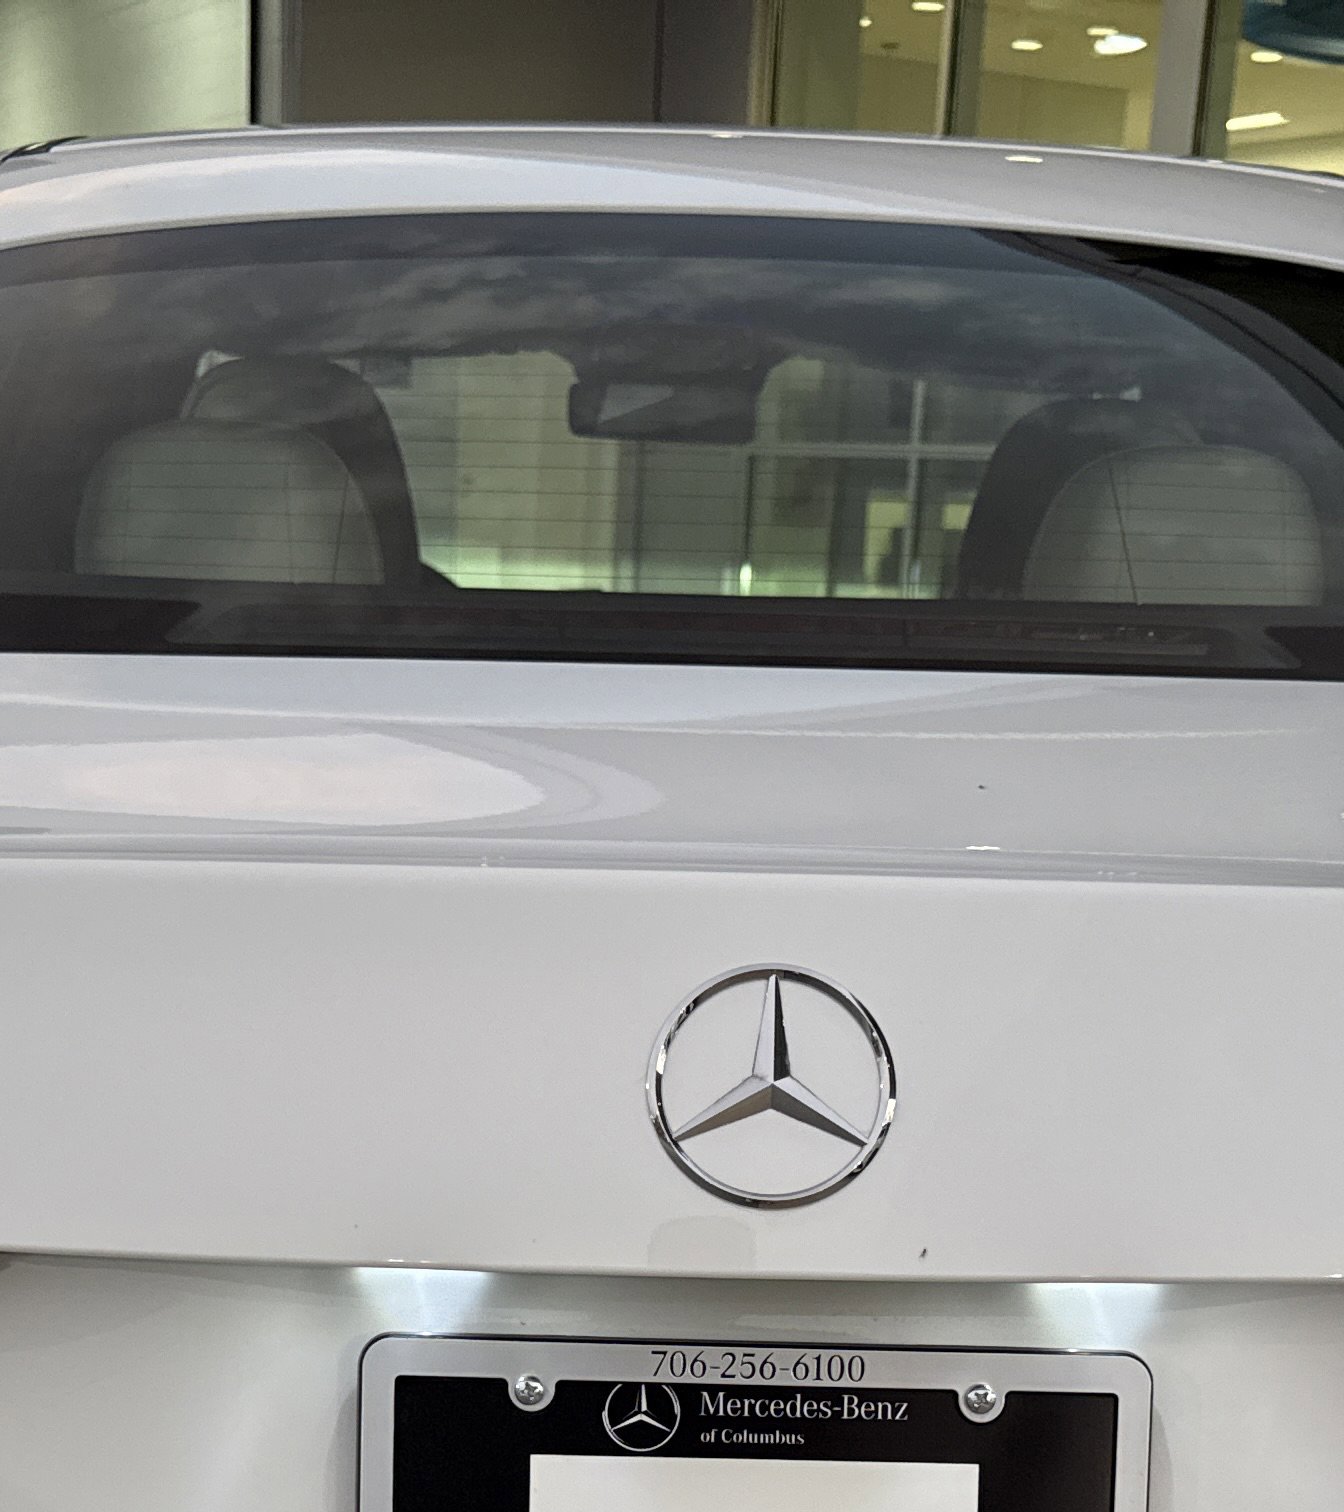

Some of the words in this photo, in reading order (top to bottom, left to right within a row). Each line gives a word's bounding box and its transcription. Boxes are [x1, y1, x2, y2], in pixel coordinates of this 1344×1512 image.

[650, 1349, 866, 1383] 706-256-6100
[698, 1391, 909, 1421] Mercedes-Benz
[700, 1428, 718, 1443] of
[721, 1429, 805, 1445] Columbus
